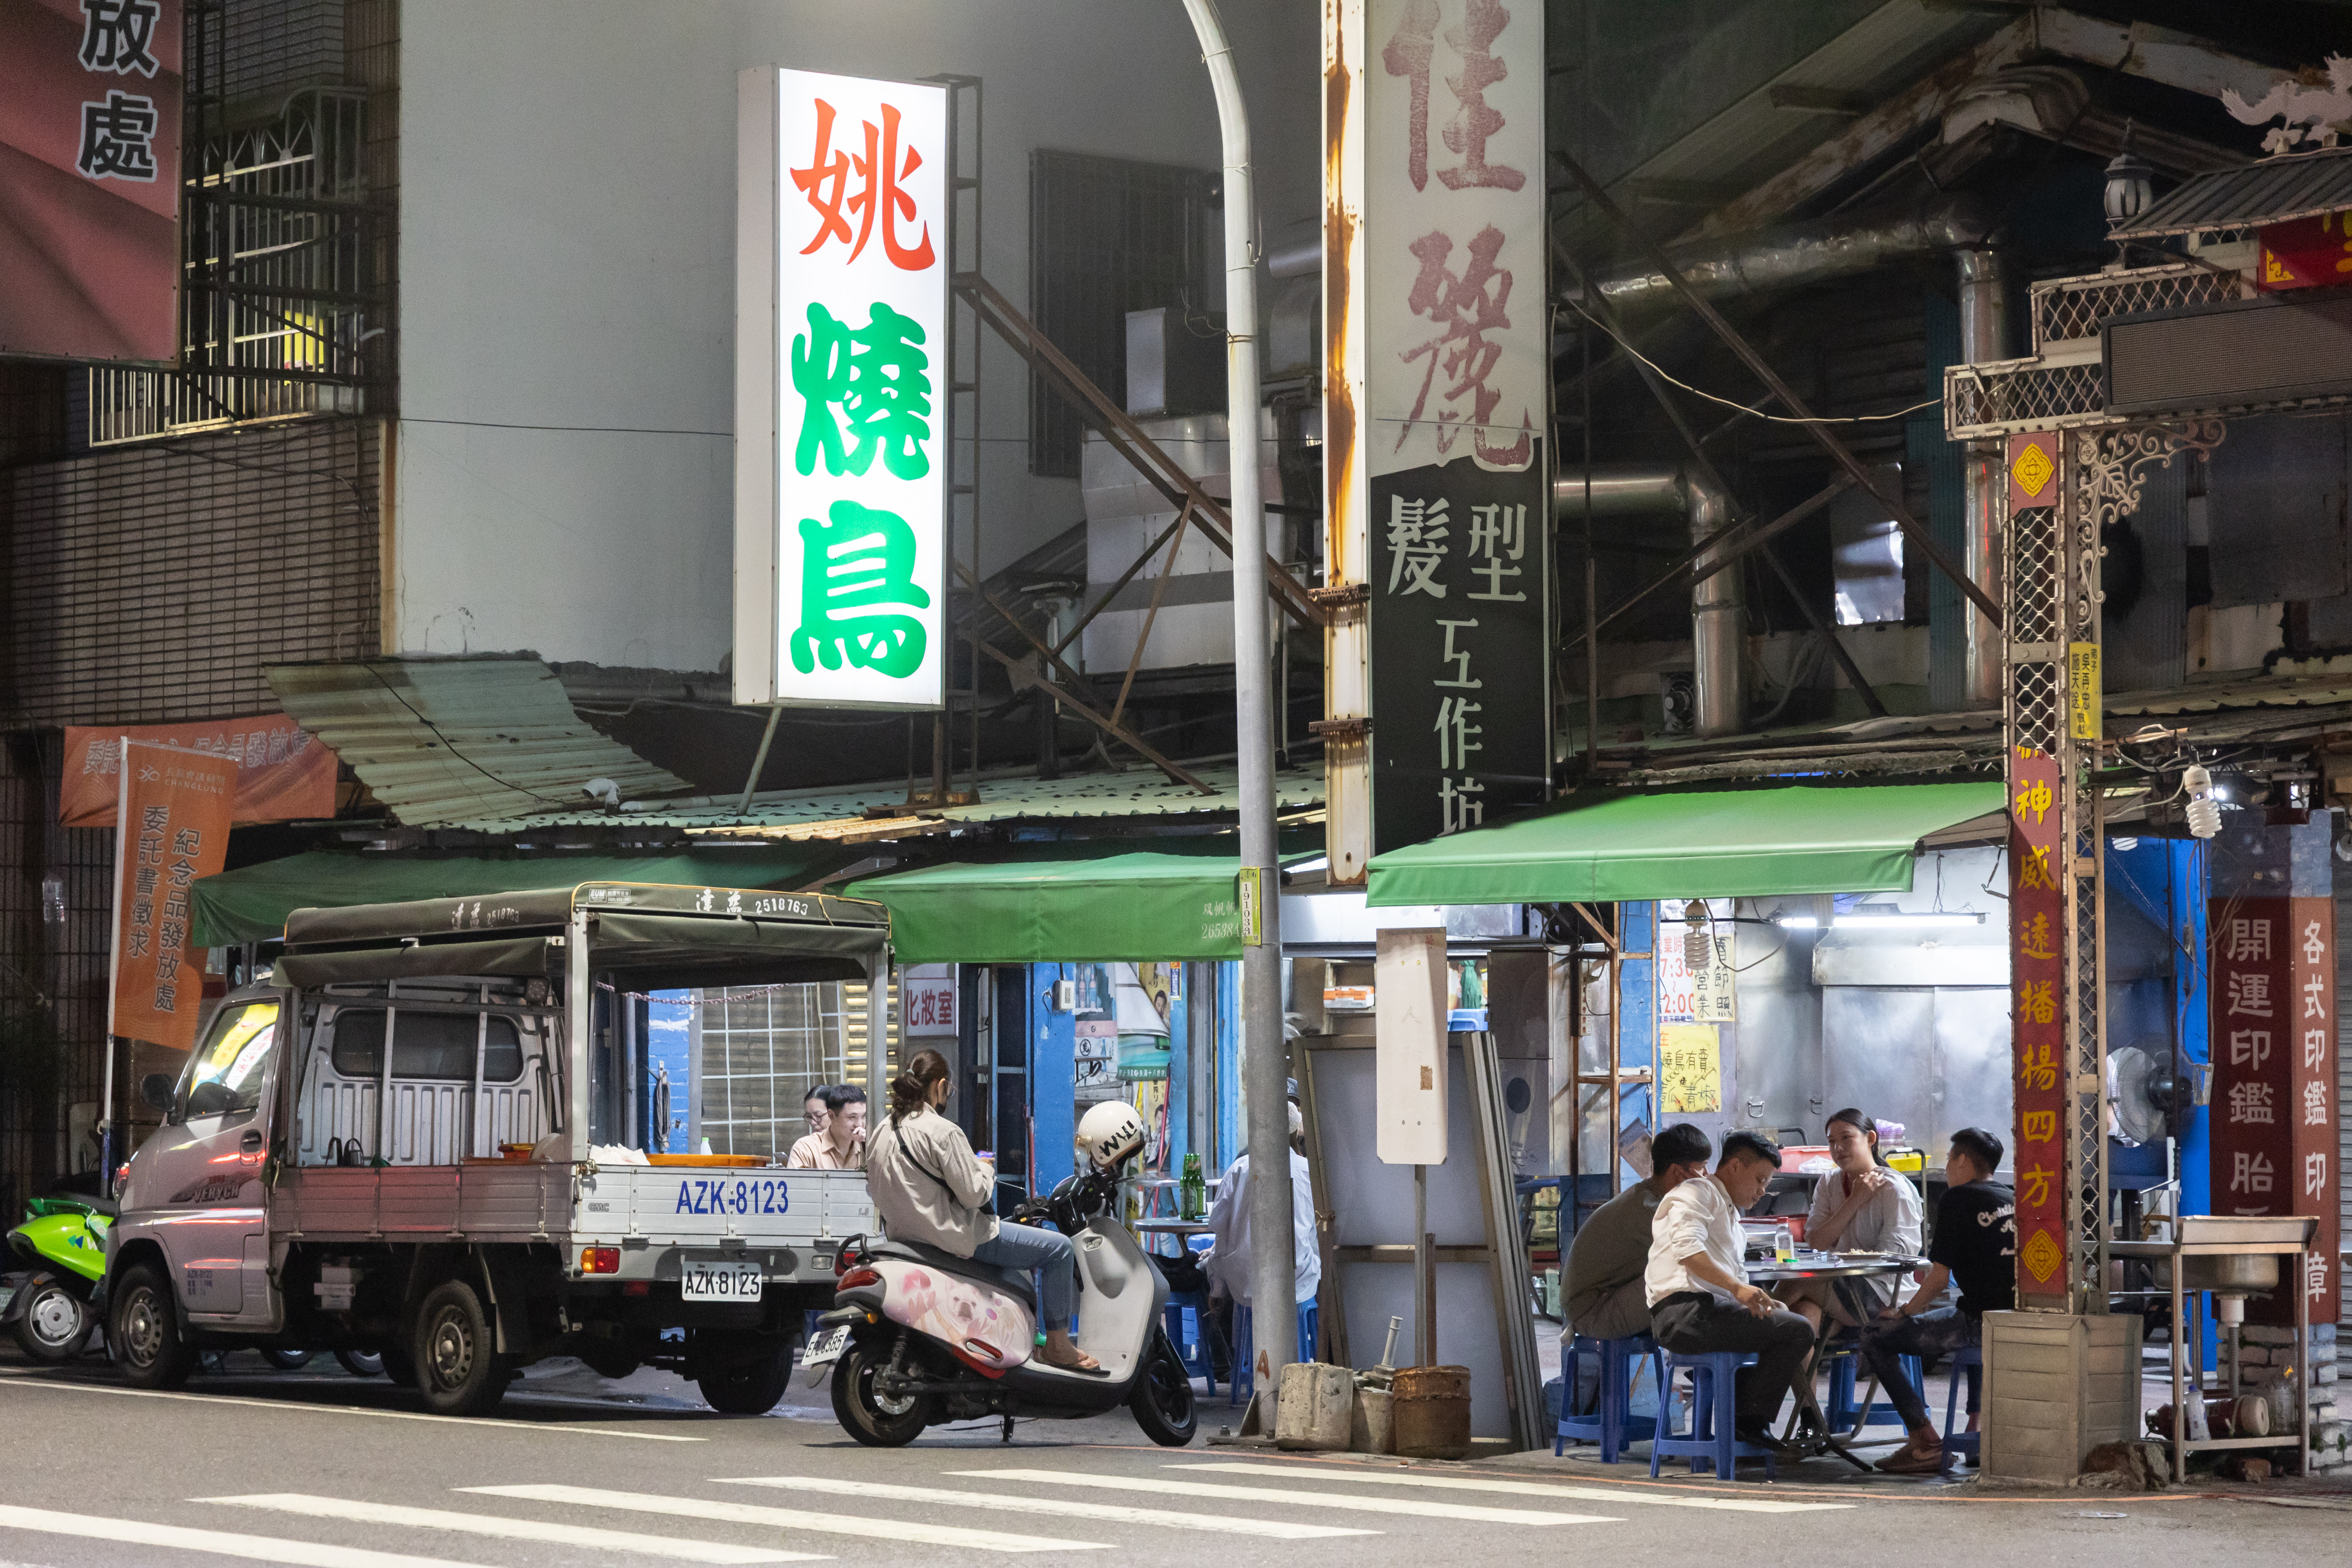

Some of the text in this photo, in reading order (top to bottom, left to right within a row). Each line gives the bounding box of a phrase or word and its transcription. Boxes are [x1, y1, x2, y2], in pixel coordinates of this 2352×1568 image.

[75, 0, 160, 182] 放處
[790, 98, 936, 679] 姚燒鳥
[1387, 494, 1527, 601] 髮型
[2091, 648, 2098, 672] 弟子
[165, 779, 224, 794] CHANGLUNG
[1433, 618, 1485, 837] 工作坊
[127, 805, 169, 958] 委託書徵求
[154, 827, 201, 1013] 紀念品發放處
[755, 898, 808, 916] 2518763
[905, 989, 952, 1026] 化妝室
[2016, 746, 2058, 1207] 神威遠播揚四方
[676, 1180, 788, 1214] AZK-8123
